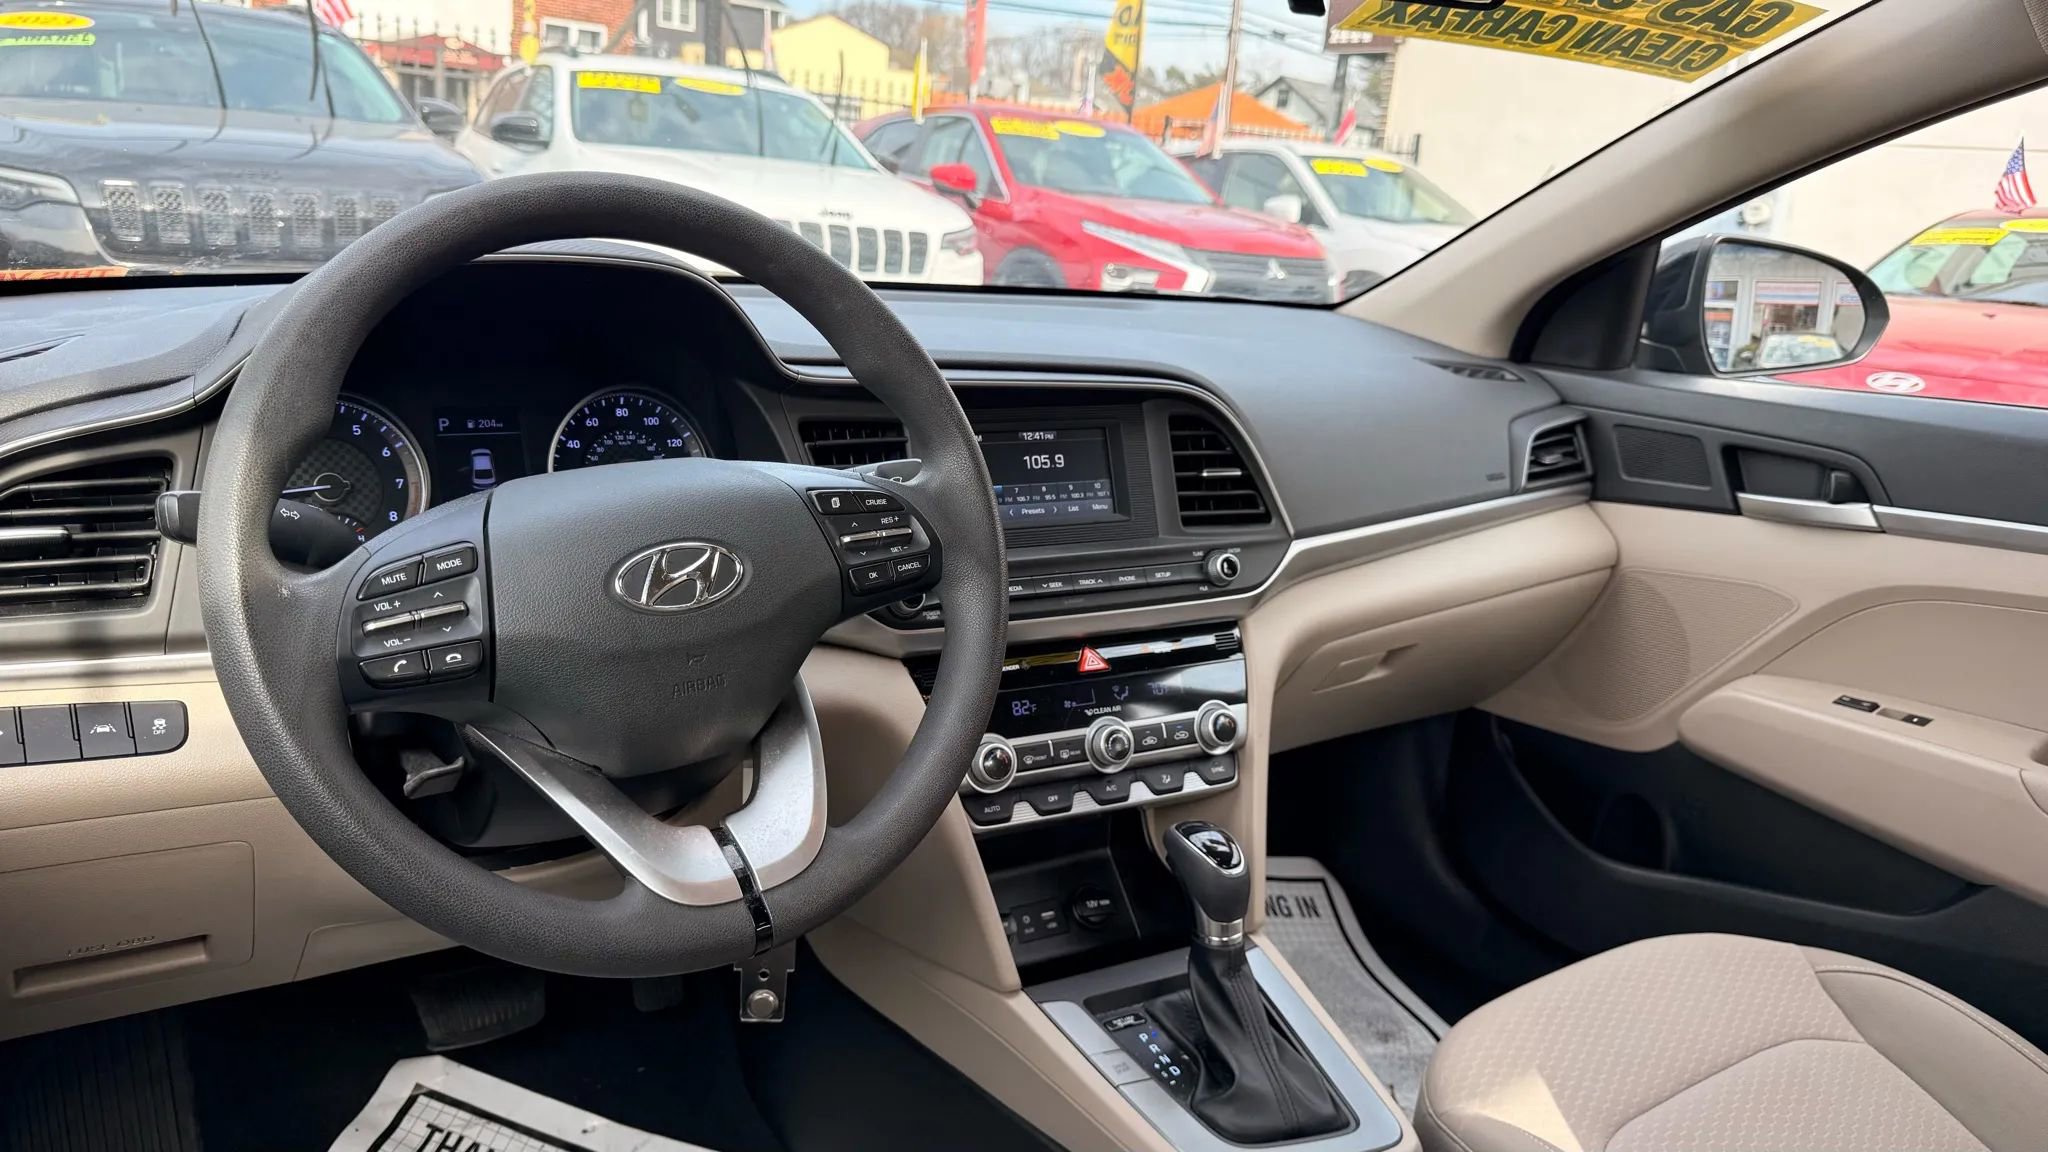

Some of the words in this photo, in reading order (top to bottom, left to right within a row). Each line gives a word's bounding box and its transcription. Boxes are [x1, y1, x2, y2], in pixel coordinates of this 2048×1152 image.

[615, 407, 629, 417] 80
[439, 418, 450, 431] P
[478, 419, 496, 428] 204
[585, 417, 599, 427] 60
[643, 416, 660, 426] 100
[352, 424, 361, 435] 5
[1022, 432, 1045, 440] 12:41
[567, 439, 581, 449] 40
[666, 438, 683, 447] 120
[382, 446, 391, 457] 6
[1023, 454, 1065, 469] 105.9
[395, 478, 404, 489] 7
[388, 511, 398, 522] 8
[881, 517, 894, 525] RES
[436, 558, 463, 571] MODE
[897, 561, 922, 572] CANCEL
[381, 573, 407, 585] MUTE
[374, 601, 393, 612] VOL
[384, 638, 403, 648] VOL
[673, 674, 727, 699] AIRBAG
[1093, 706, 1111, 715] CLEAN
[1111, 704, 1122, 712] AIR
[1106, 784, 1117, 792] A/C
[984, 805, 1000, 813] AUTO
[1294, 895, 1321, 918] IN
[1139, 1033, 1148, 1042] P
[1149, 1044, 1160, 1054] R
[1159, 1054, 1171, 1065] N
[1169, 1065, 1181, 1076] D
